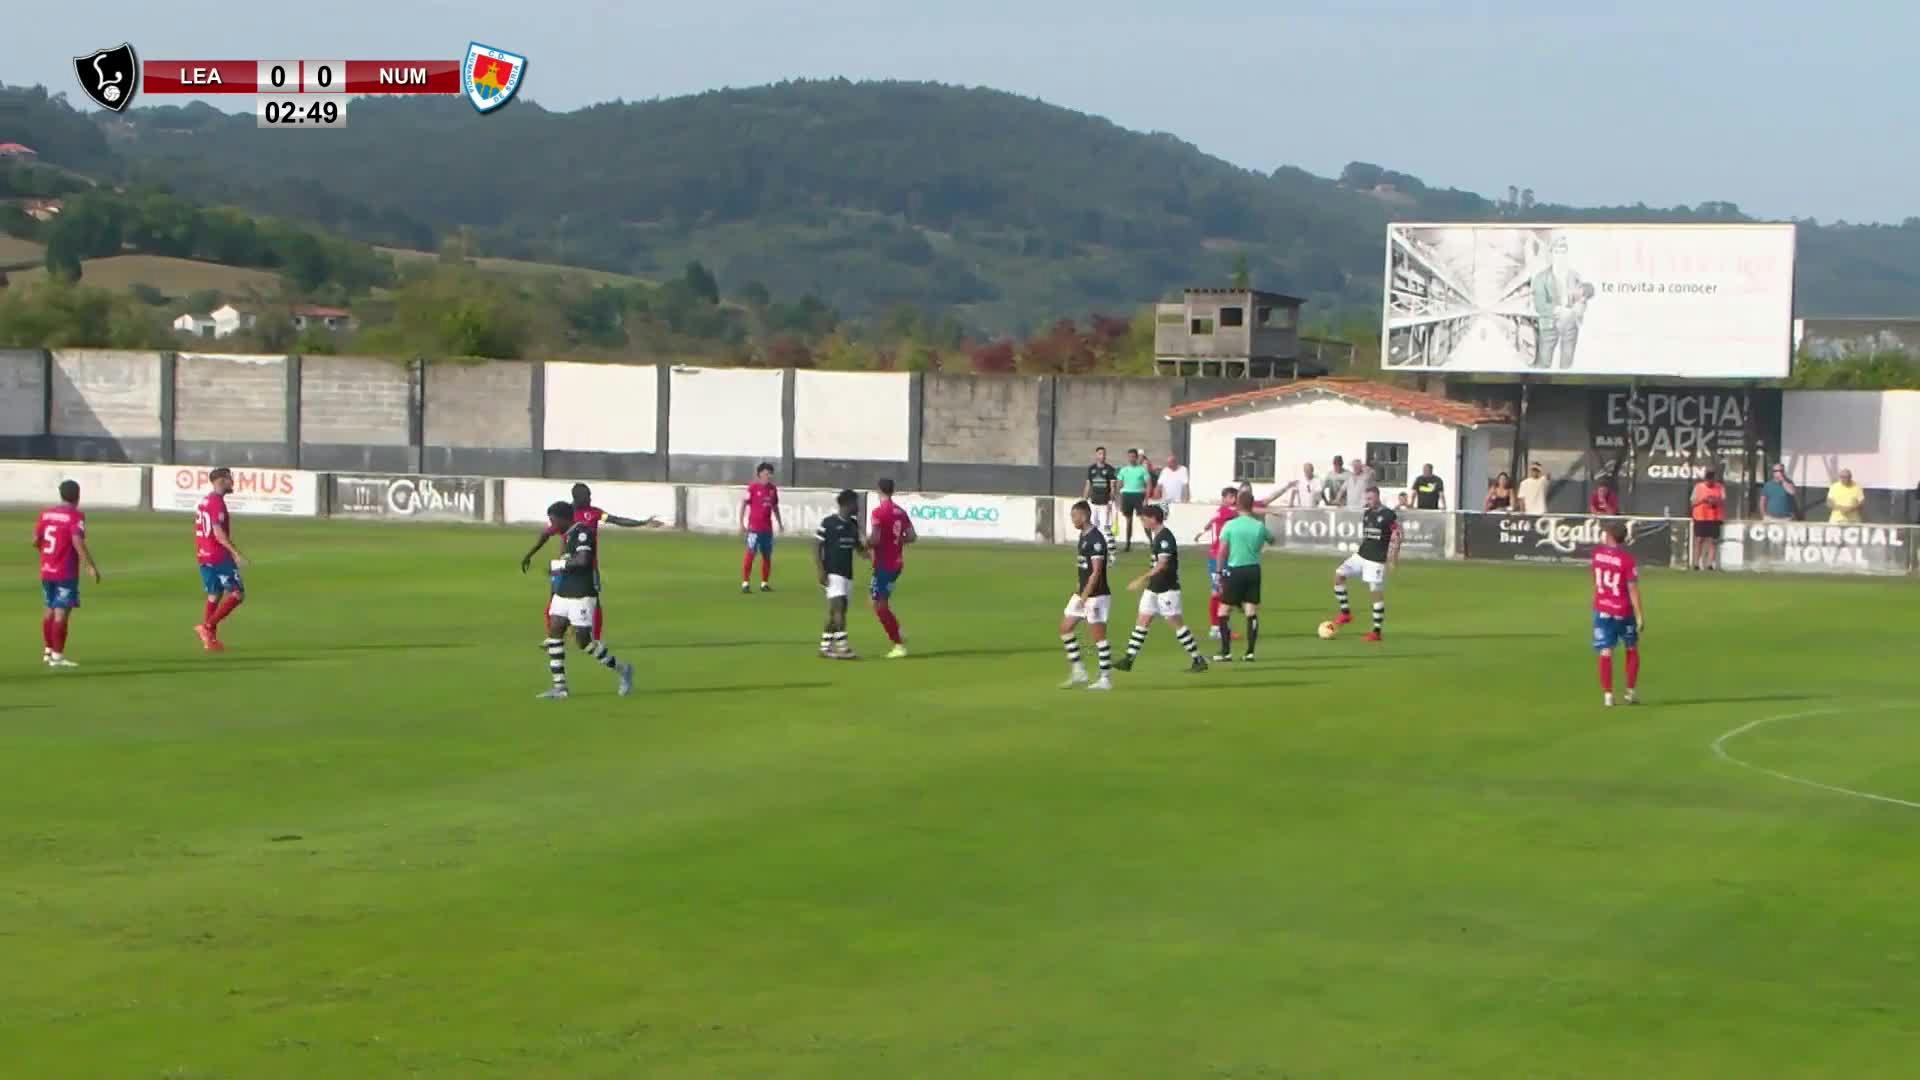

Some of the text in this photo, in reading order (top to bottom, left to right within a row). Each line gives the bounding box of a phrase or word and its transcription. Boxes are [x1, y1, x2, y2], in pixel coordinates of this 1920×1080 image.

[1602, 281, 1718, 295] te invita a conocer
[1633, 426, 1715, 458] PARK
[176, 470, 294, 494] OPMUS
[909, 504, 1000, 522] AGROLAGO
[1500, 519, 1531, 532] Café
[1749, 524, 1904, 547] COMERCIAL
[43, 525, 57, 554] 5
[1500, 532, 1524, 544] Bar
[1784, 545, 1869, 569] NOVAL
[1595, 566, 1621, 597] 14
